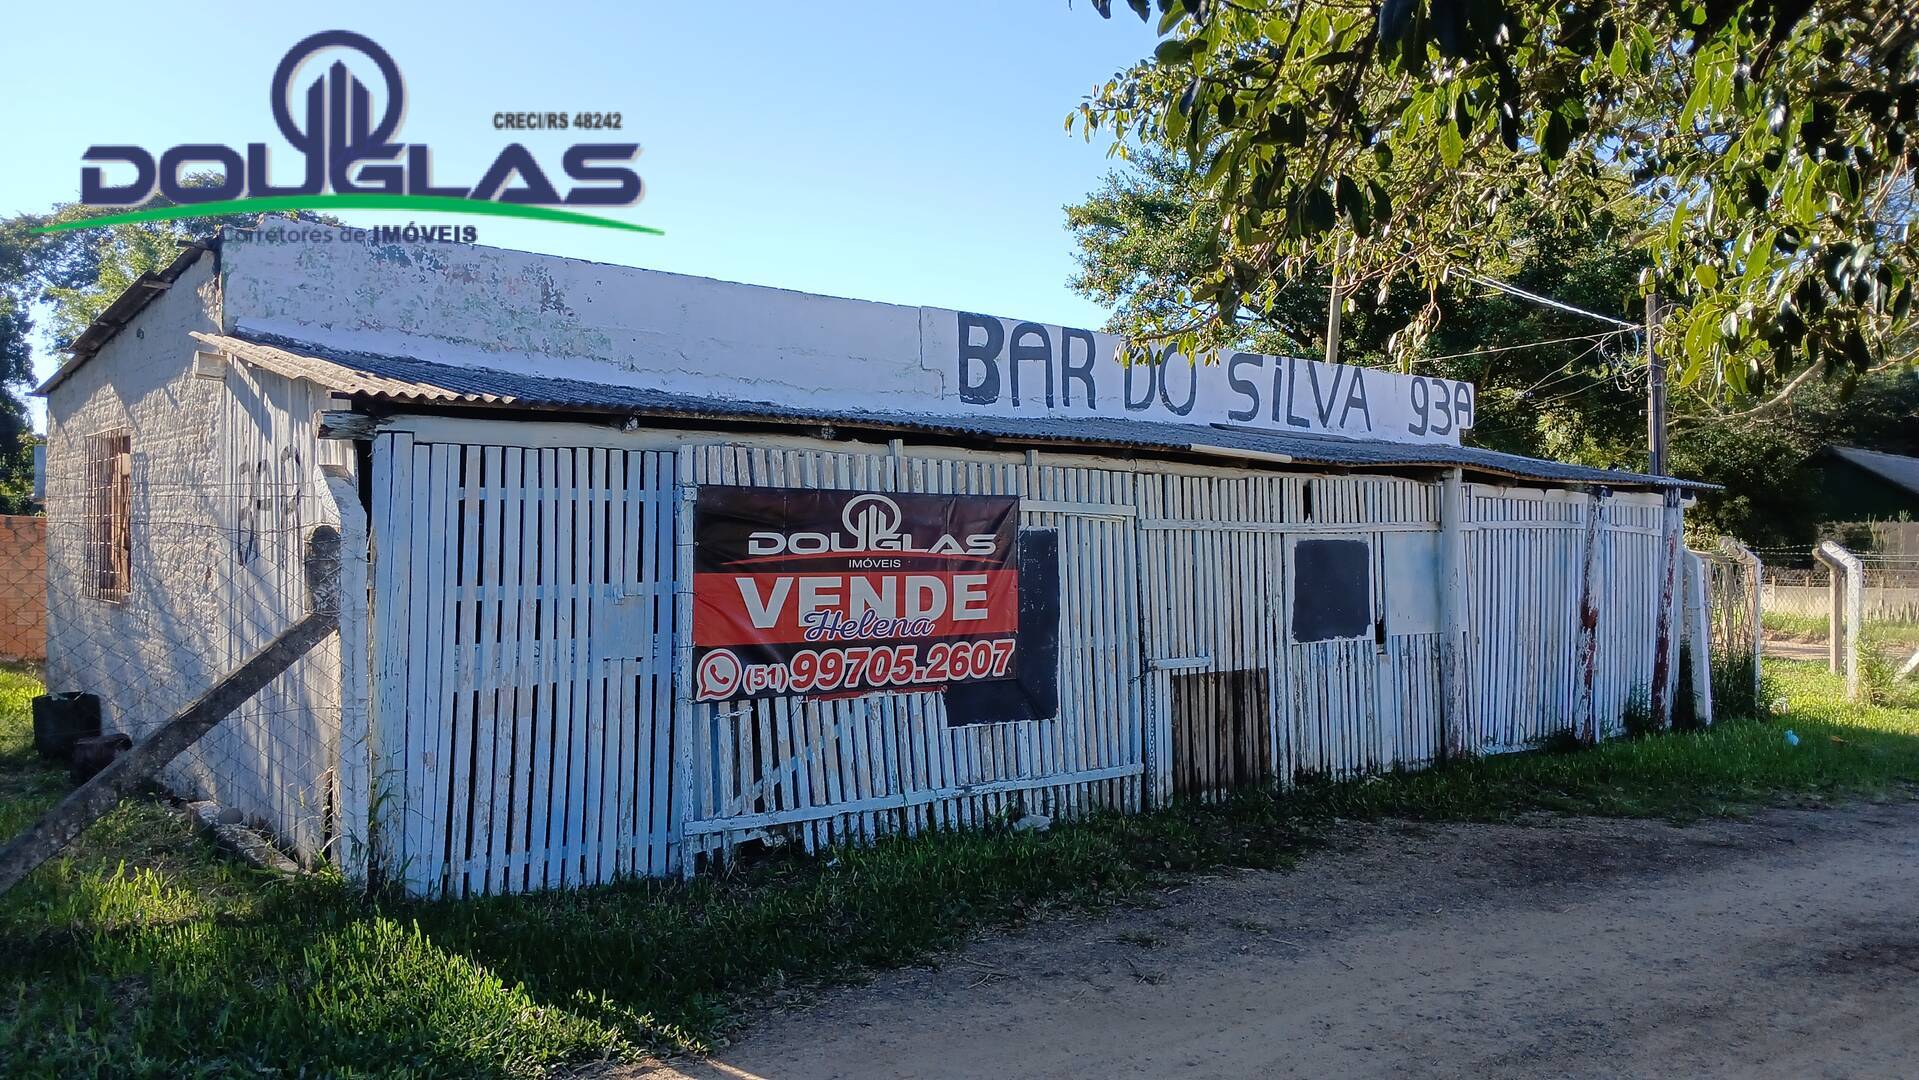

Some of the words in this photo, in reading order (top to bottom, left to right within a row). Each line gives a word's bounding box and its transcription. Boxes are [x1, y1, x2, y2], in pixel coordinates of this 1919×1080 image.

[957, 312, 1096, 411] BAR
[1124, 335, 1197, 417] DO
[1408, 376, 1472, 436] 93A
[748, 532, 997, 555] DOUGLAS
[849, 557, 901, 568] IMÓVEIS
[735, 574, 988, 629] VENDE
[803, 609, 935, 641] Helena
